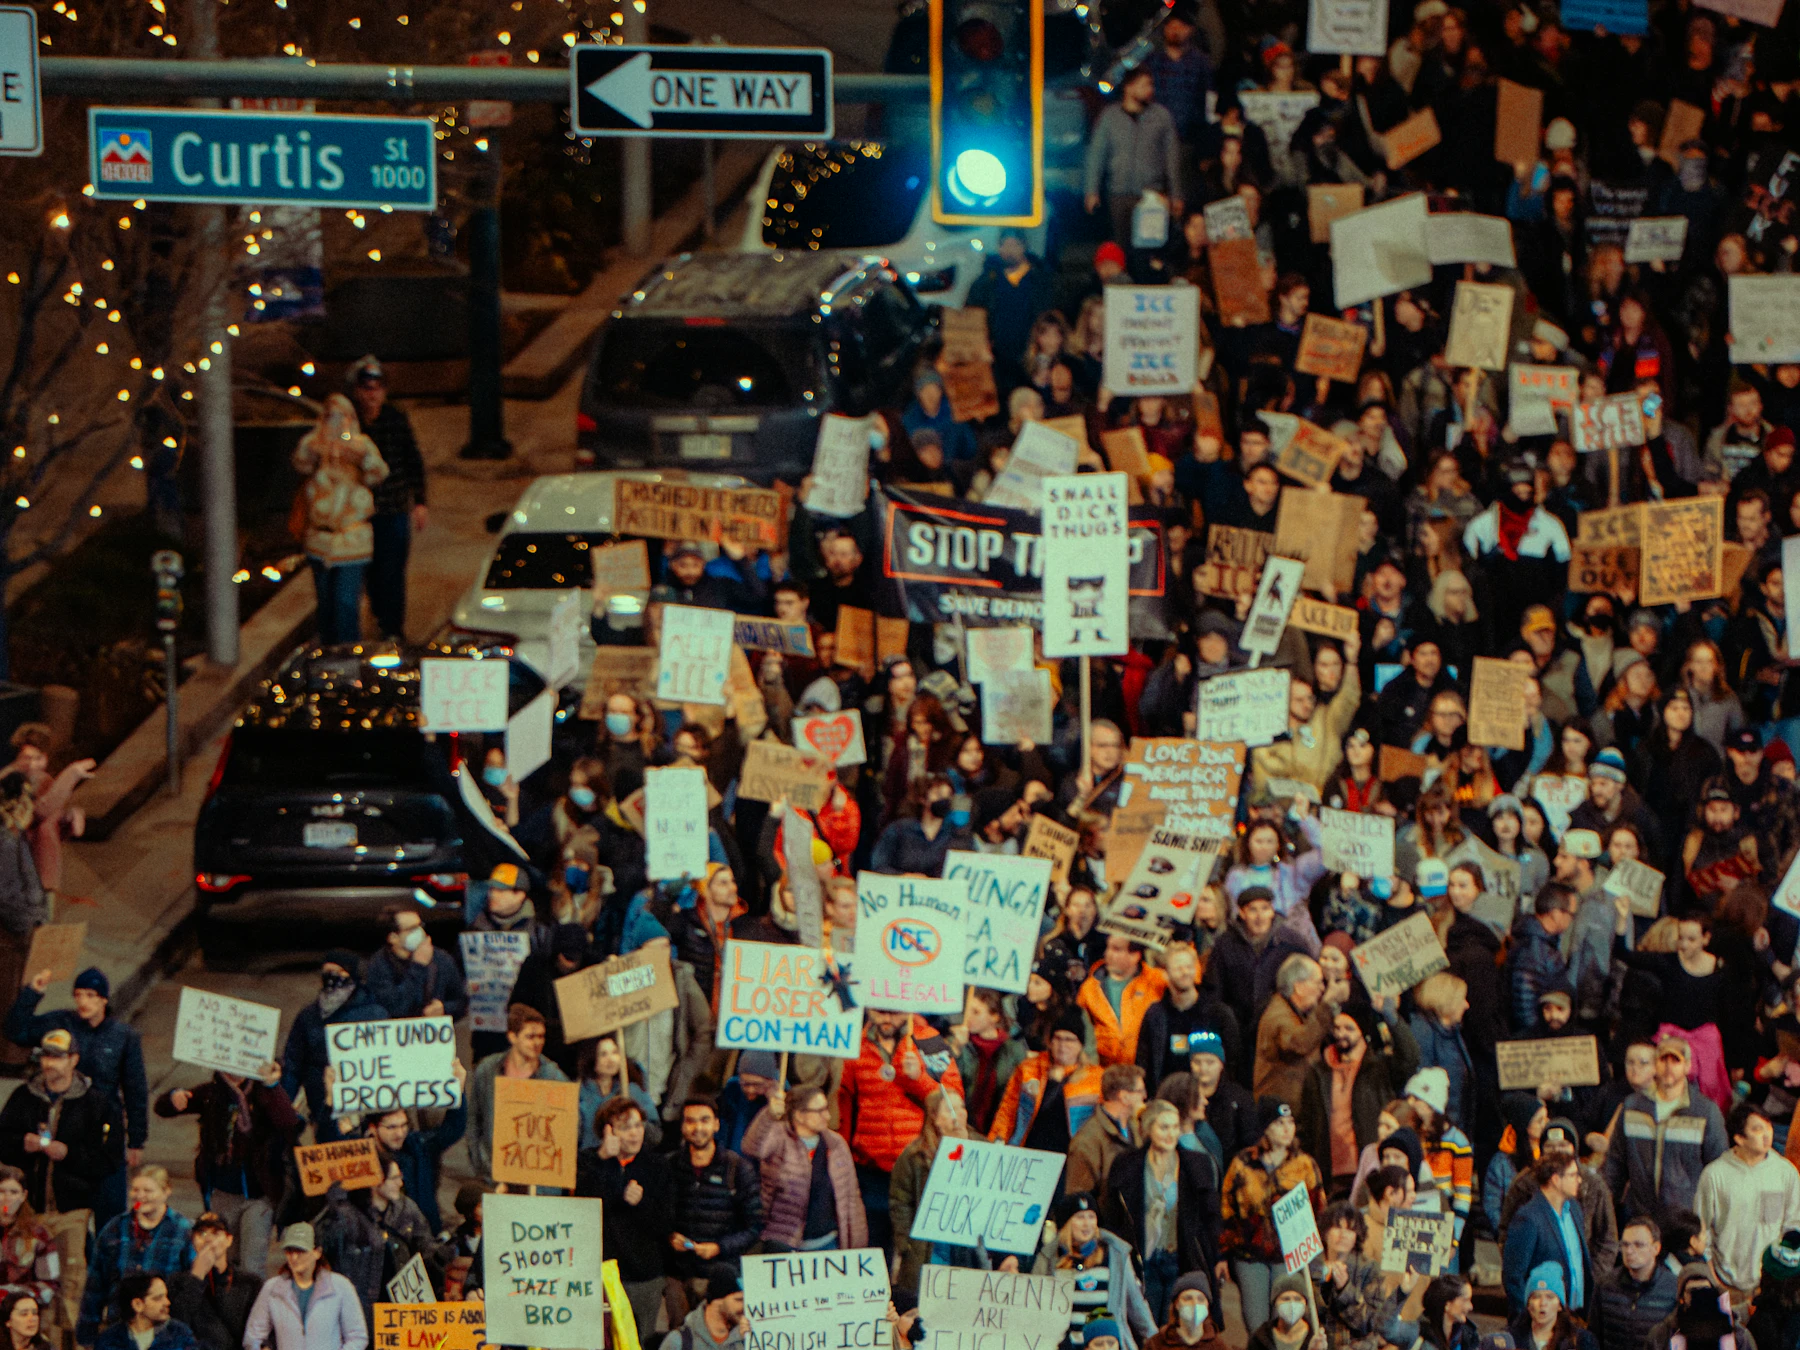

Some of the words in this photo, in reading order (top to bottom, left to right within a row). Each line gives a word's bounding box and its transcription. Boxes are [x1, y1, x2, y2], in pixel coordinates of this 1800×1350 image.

[653, 76, 717, 107] ONE
[731, 77, 799, 109] WAY
[171, 131, 345, 191] Curtis
[384, 138, 411, 162] St
[371, 165, 426, 190] 1000
[1057, 503, 1118, 521] DICK
[1050, 521, 1122, 539] THUGS
[907, 521, 1004, 572] STOP
[1144, 743, 1195, 764] LOVE
[1200, 745, 1236, 765] YOUR
[1152, 829, 1190, 850] SAME
[860, 891, 889, 918] No
[899, 883, 960, 921] Human
[890, 926, 933, 954] ICE
[733, 945, 815, 984] LIAR
[731, 983, 829, 1018] LOSER
[395, 1022, 454, 1048] UNDO
[725, 1015, 853, 1050] CON-MAN
[340, 1055, 396, 1083] DUE
[338, 1078, 457, 1113] PROCESS
[512, 1112, 556, 1141] FUCK
[309, 1167, 324, 1183] IS
[990, 1149, 1044, 1196] NICE
[921, 1192, 973, 1236] FUCK
[978, 1198, 1023, 1242] ICE
[511, 1221, 574, 1243] DON'T
[499, 1247, 575, 1274] SHOOT!
[1283, 1231, 1324, 1274] MIGRA
[763, 1254, 875, 1288] THINK
[566, 1280, 594, 1297] ME
[747, 1297, 809, 1319] WHILE
[862, 1286, 888, 1300] CAN
[922, 1267, 958, 1301] ICE
[979, 1271, 1073, 1315] AGENTS
[383, 1309, 407, 1328] IF
[410, 1309, 438, 1325] THIS
[444, 1310, 455, 1324] IS
[525, 1304, 573, 1326] BRO
[971, 1307, 1008, 1329] ARE
[377, 1332, 400, 1347] THE
[407, 1329, 448, 1348] LAW
[837, 1318, 892, 1349] ICE
